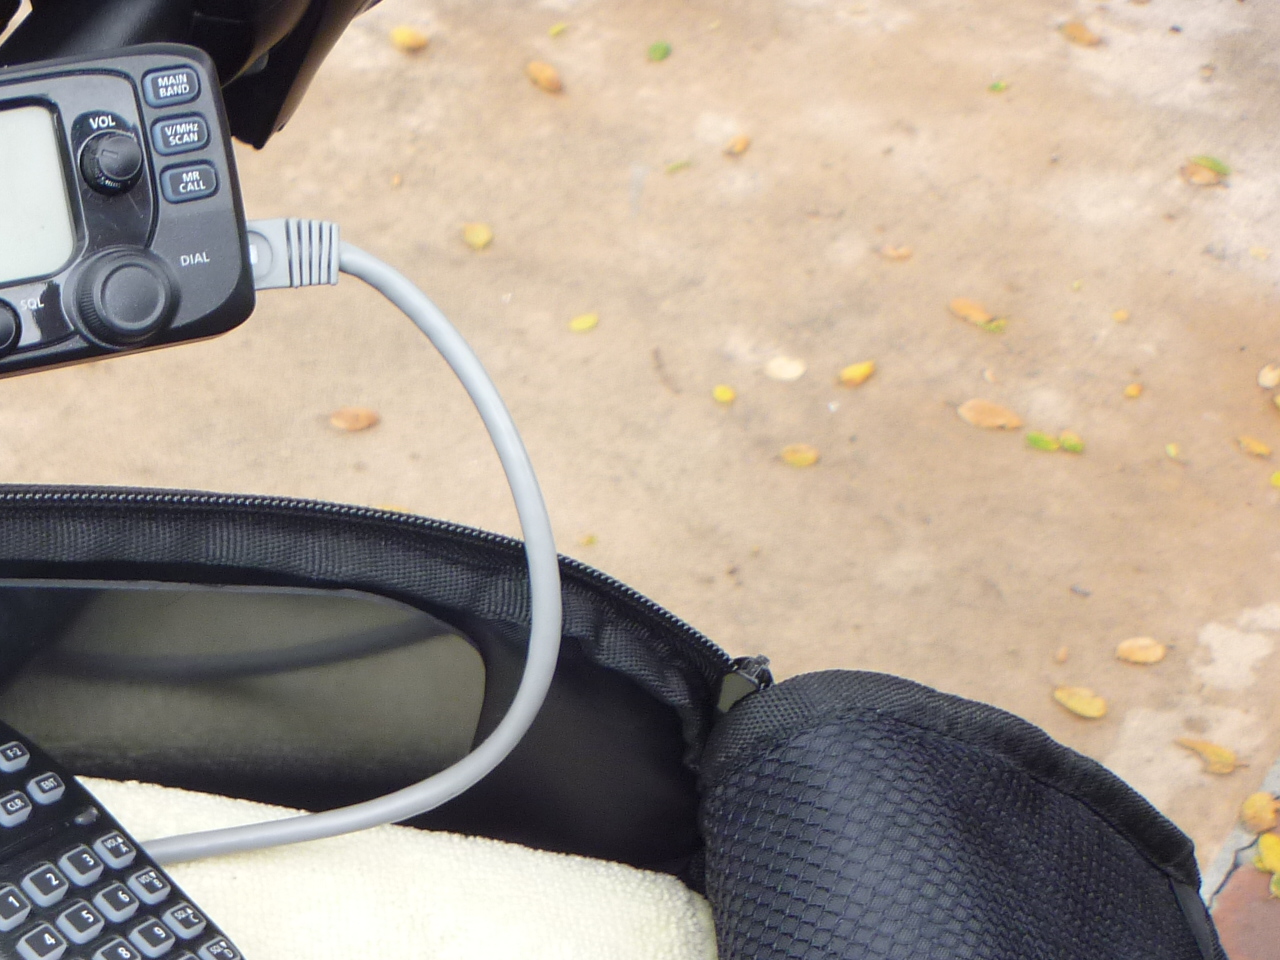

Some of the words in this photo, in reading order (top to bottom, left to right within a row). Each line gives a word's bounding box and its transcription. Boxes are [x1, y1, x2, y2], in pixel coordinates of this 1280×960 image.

[158, 74, 187, 87] MAIN
[159, 84, 190, 98] BAND
[89, 115, 116, 129] VOL
[165, 122, 199, 136] V/MHz
[169, 132, 198, 146] SCAN
[182, 171, 200, 182] MR
[179, 179, 206, 193] CALL
[181, 252, 210, 267] DIAL
[20, 297, 44, 312] SQL
[41, 778, 58, 790] ENT
[6, 798, 25, 812] CLR
[120, 844, 130, 854] A
[82, 853, 95, 866] 3
[46, 872, 60, 886] 2
[153, 878, 164, 889] B
[8, 895, 21, 908] 1
[118, 891, 131, 903] 6
[82, 910, 95, 923] 5
[189, 914, 200, 924] C
[154, 926, 167, 939] 9
[42, 934, 56, 947] 4
[119, 947, 132, 960] 8
